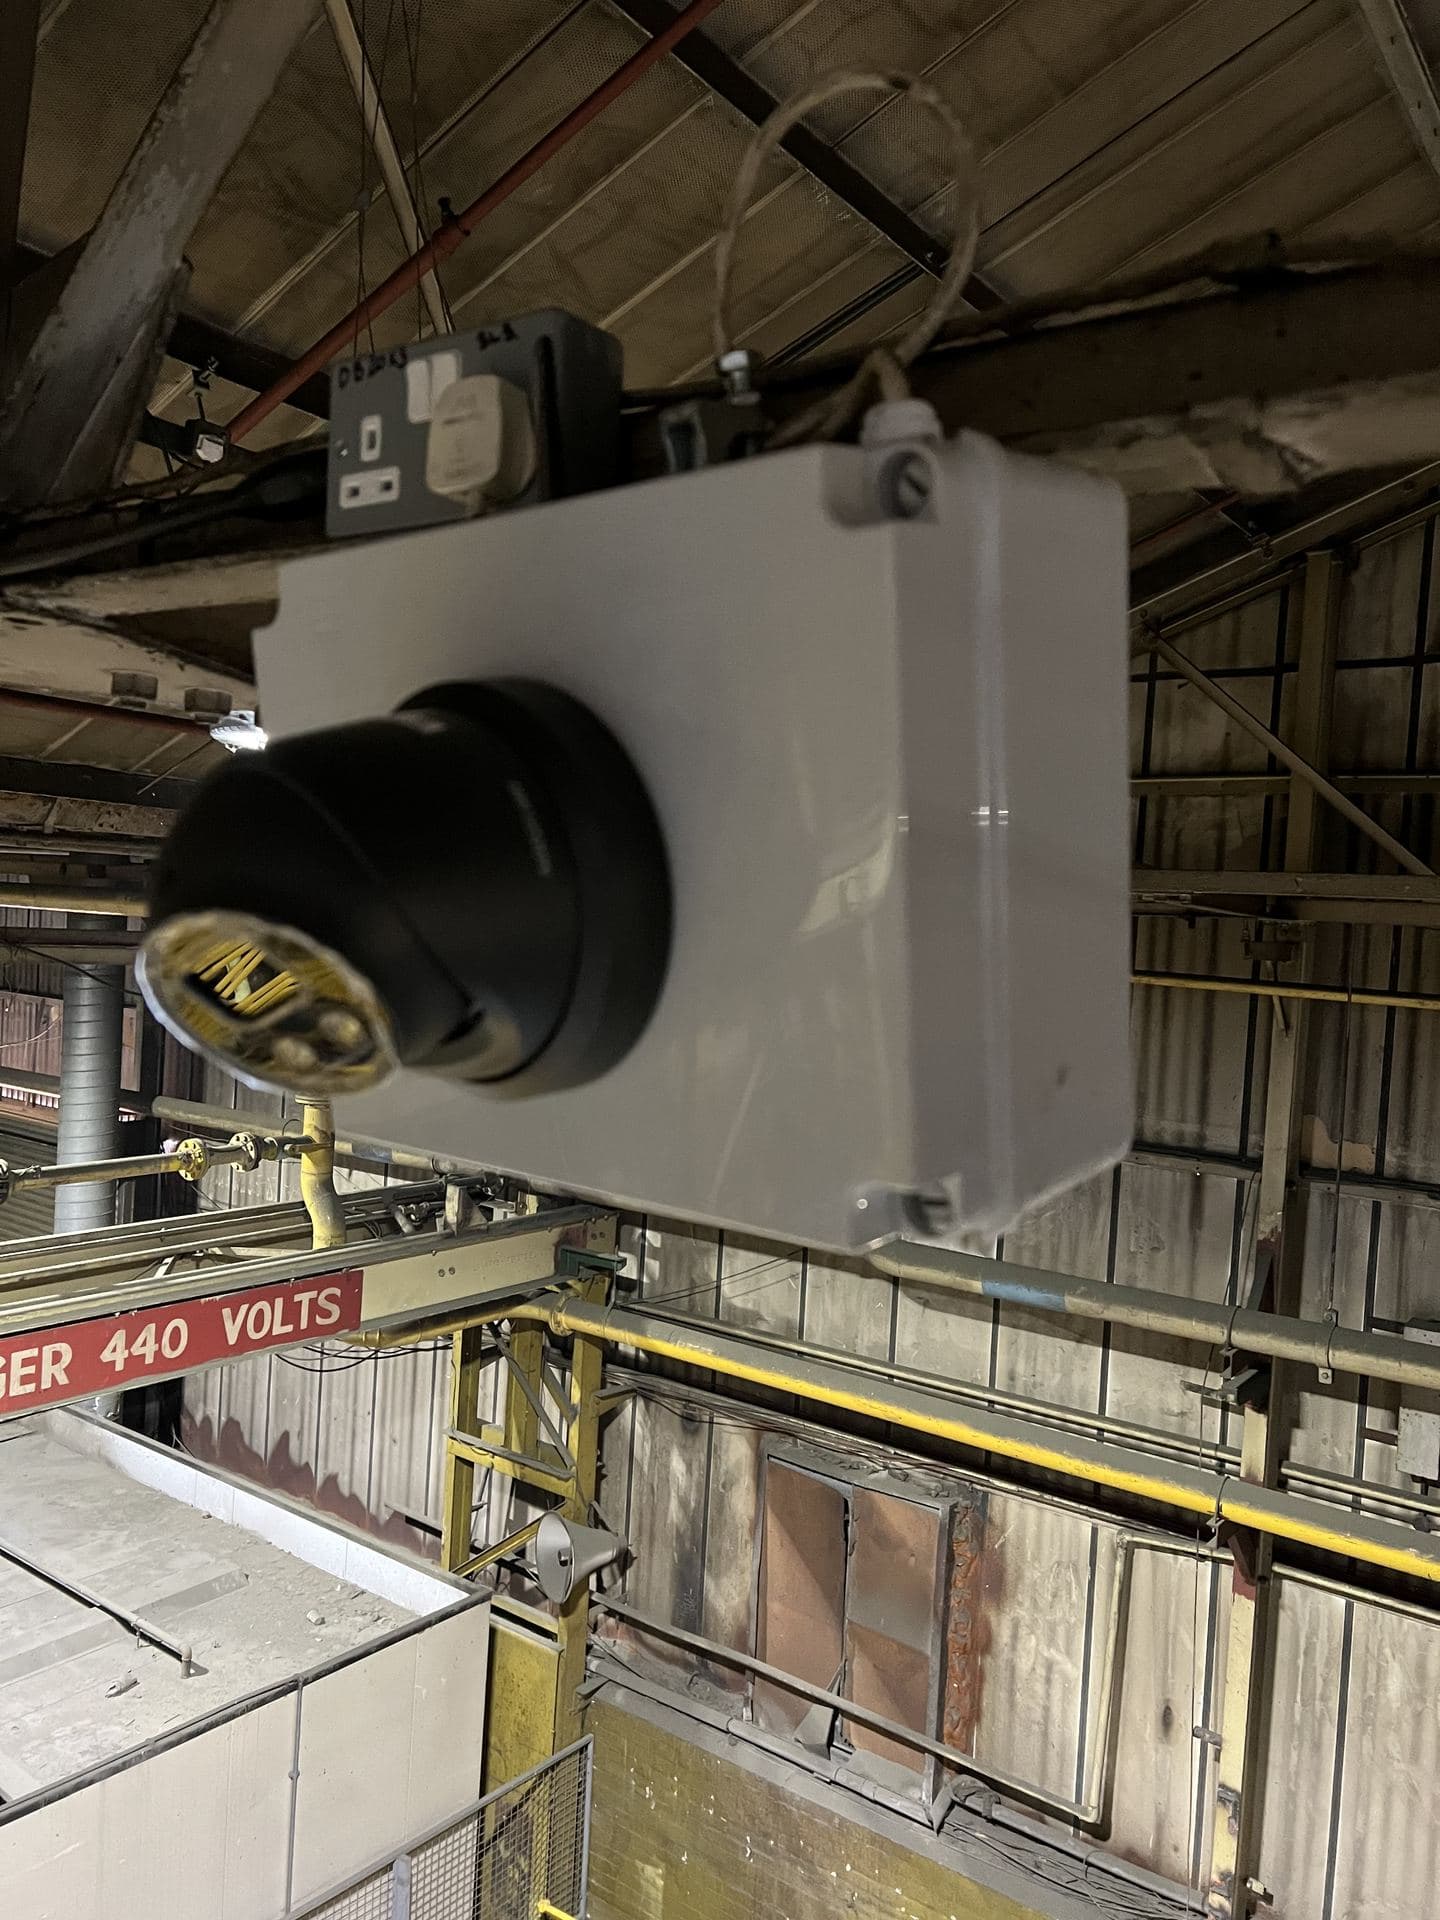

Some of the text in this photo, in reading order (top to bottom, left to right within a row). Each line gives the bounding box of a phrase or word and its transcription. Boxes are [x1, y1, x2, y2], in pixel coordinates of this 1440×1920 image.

[0, 1287, 341, 1399] ER 440 VOLTS
